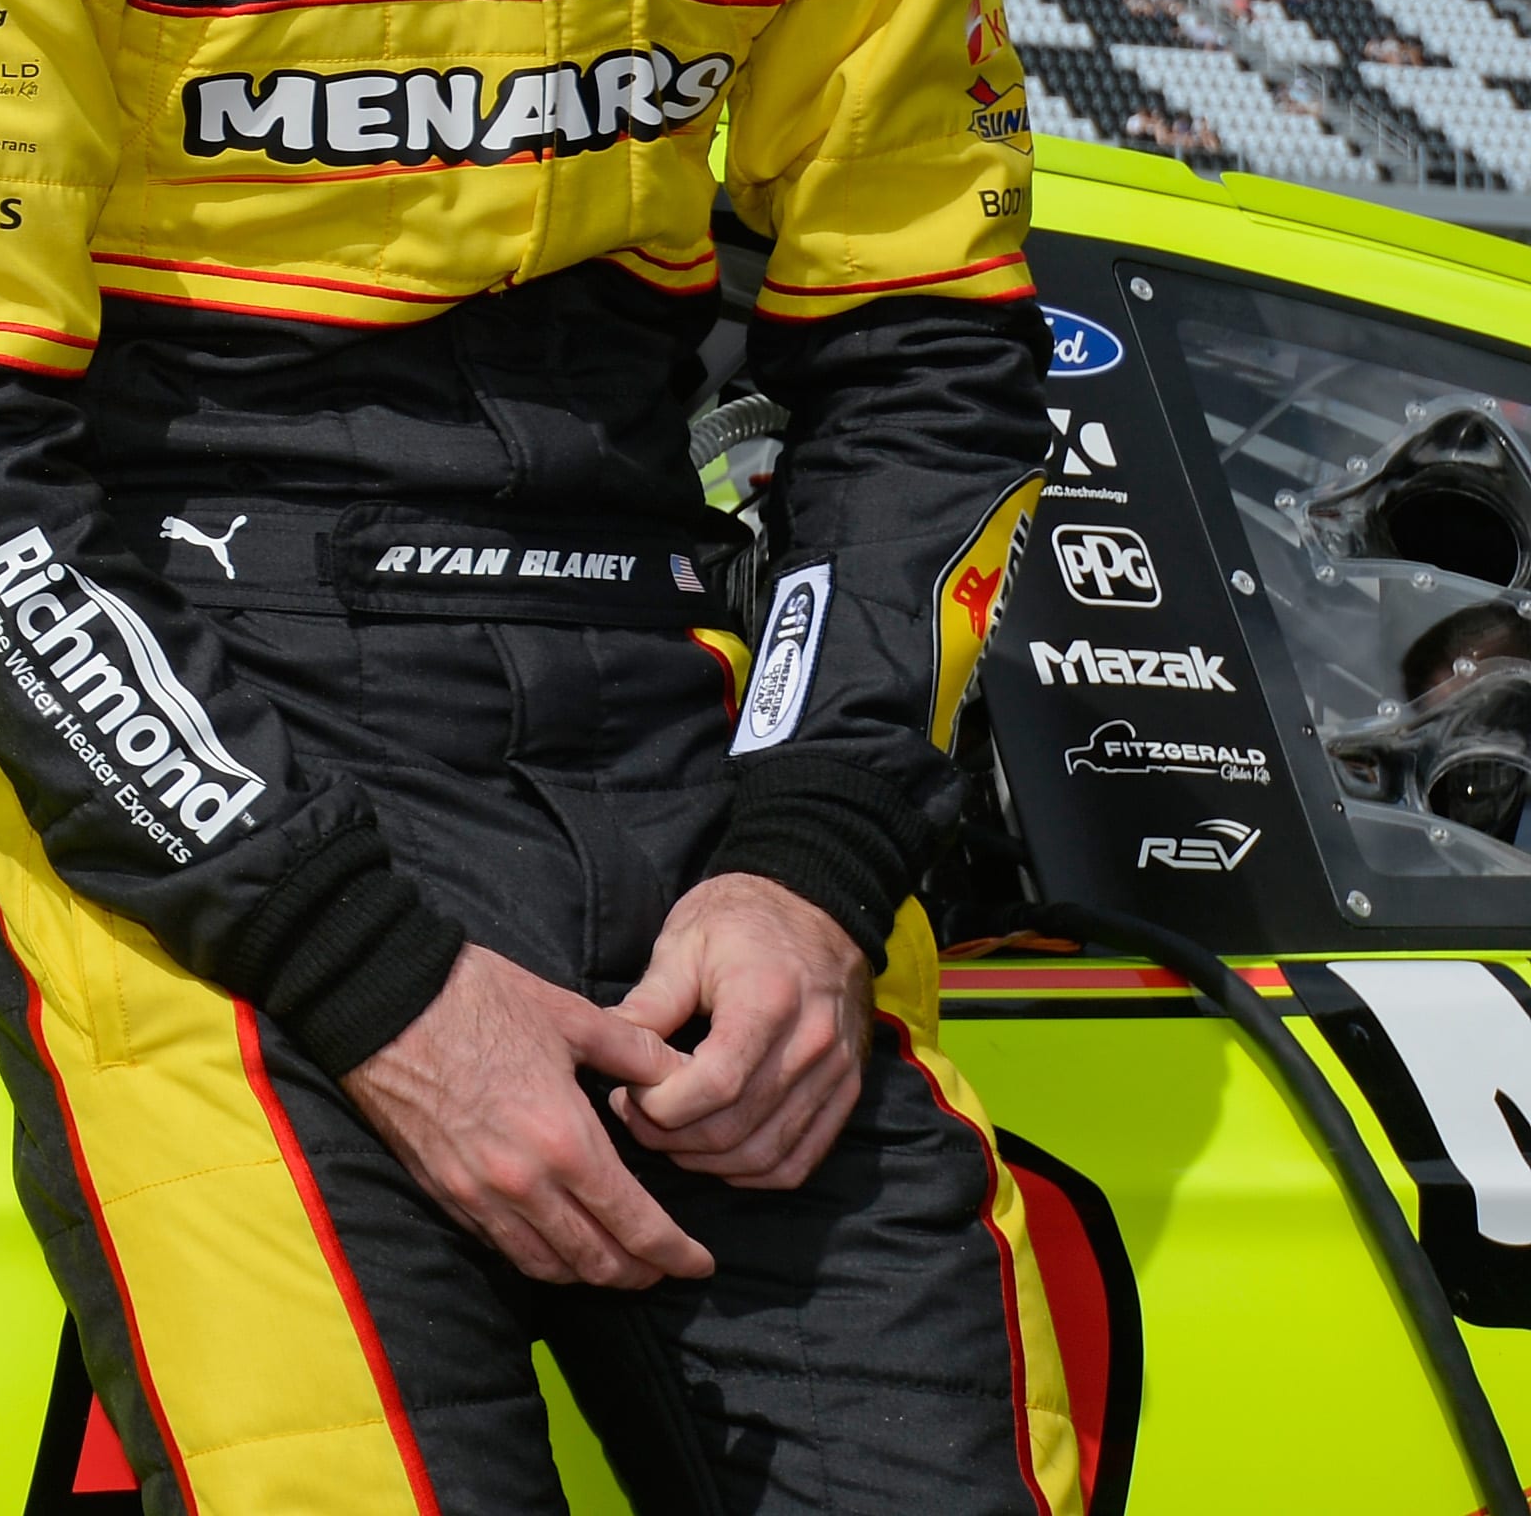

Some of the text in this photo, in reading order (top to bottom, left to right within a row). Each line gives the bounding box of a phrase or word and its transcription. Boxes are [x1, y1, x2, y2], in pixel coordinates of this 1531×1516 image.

[376, 545, 638, 582] RYAN BLANEY
[1062, 535, 1153, 596] PPG
[1029, 639, 1237, 692] Mazak
[4, 649, 64, 719] Water
[54, 713, 121, 787] Heater
[113, 783, 193, 865] Experts
[1104, 741, 1267, 766] FITZGERALD
[1138, 827, 1262, 871] REV
